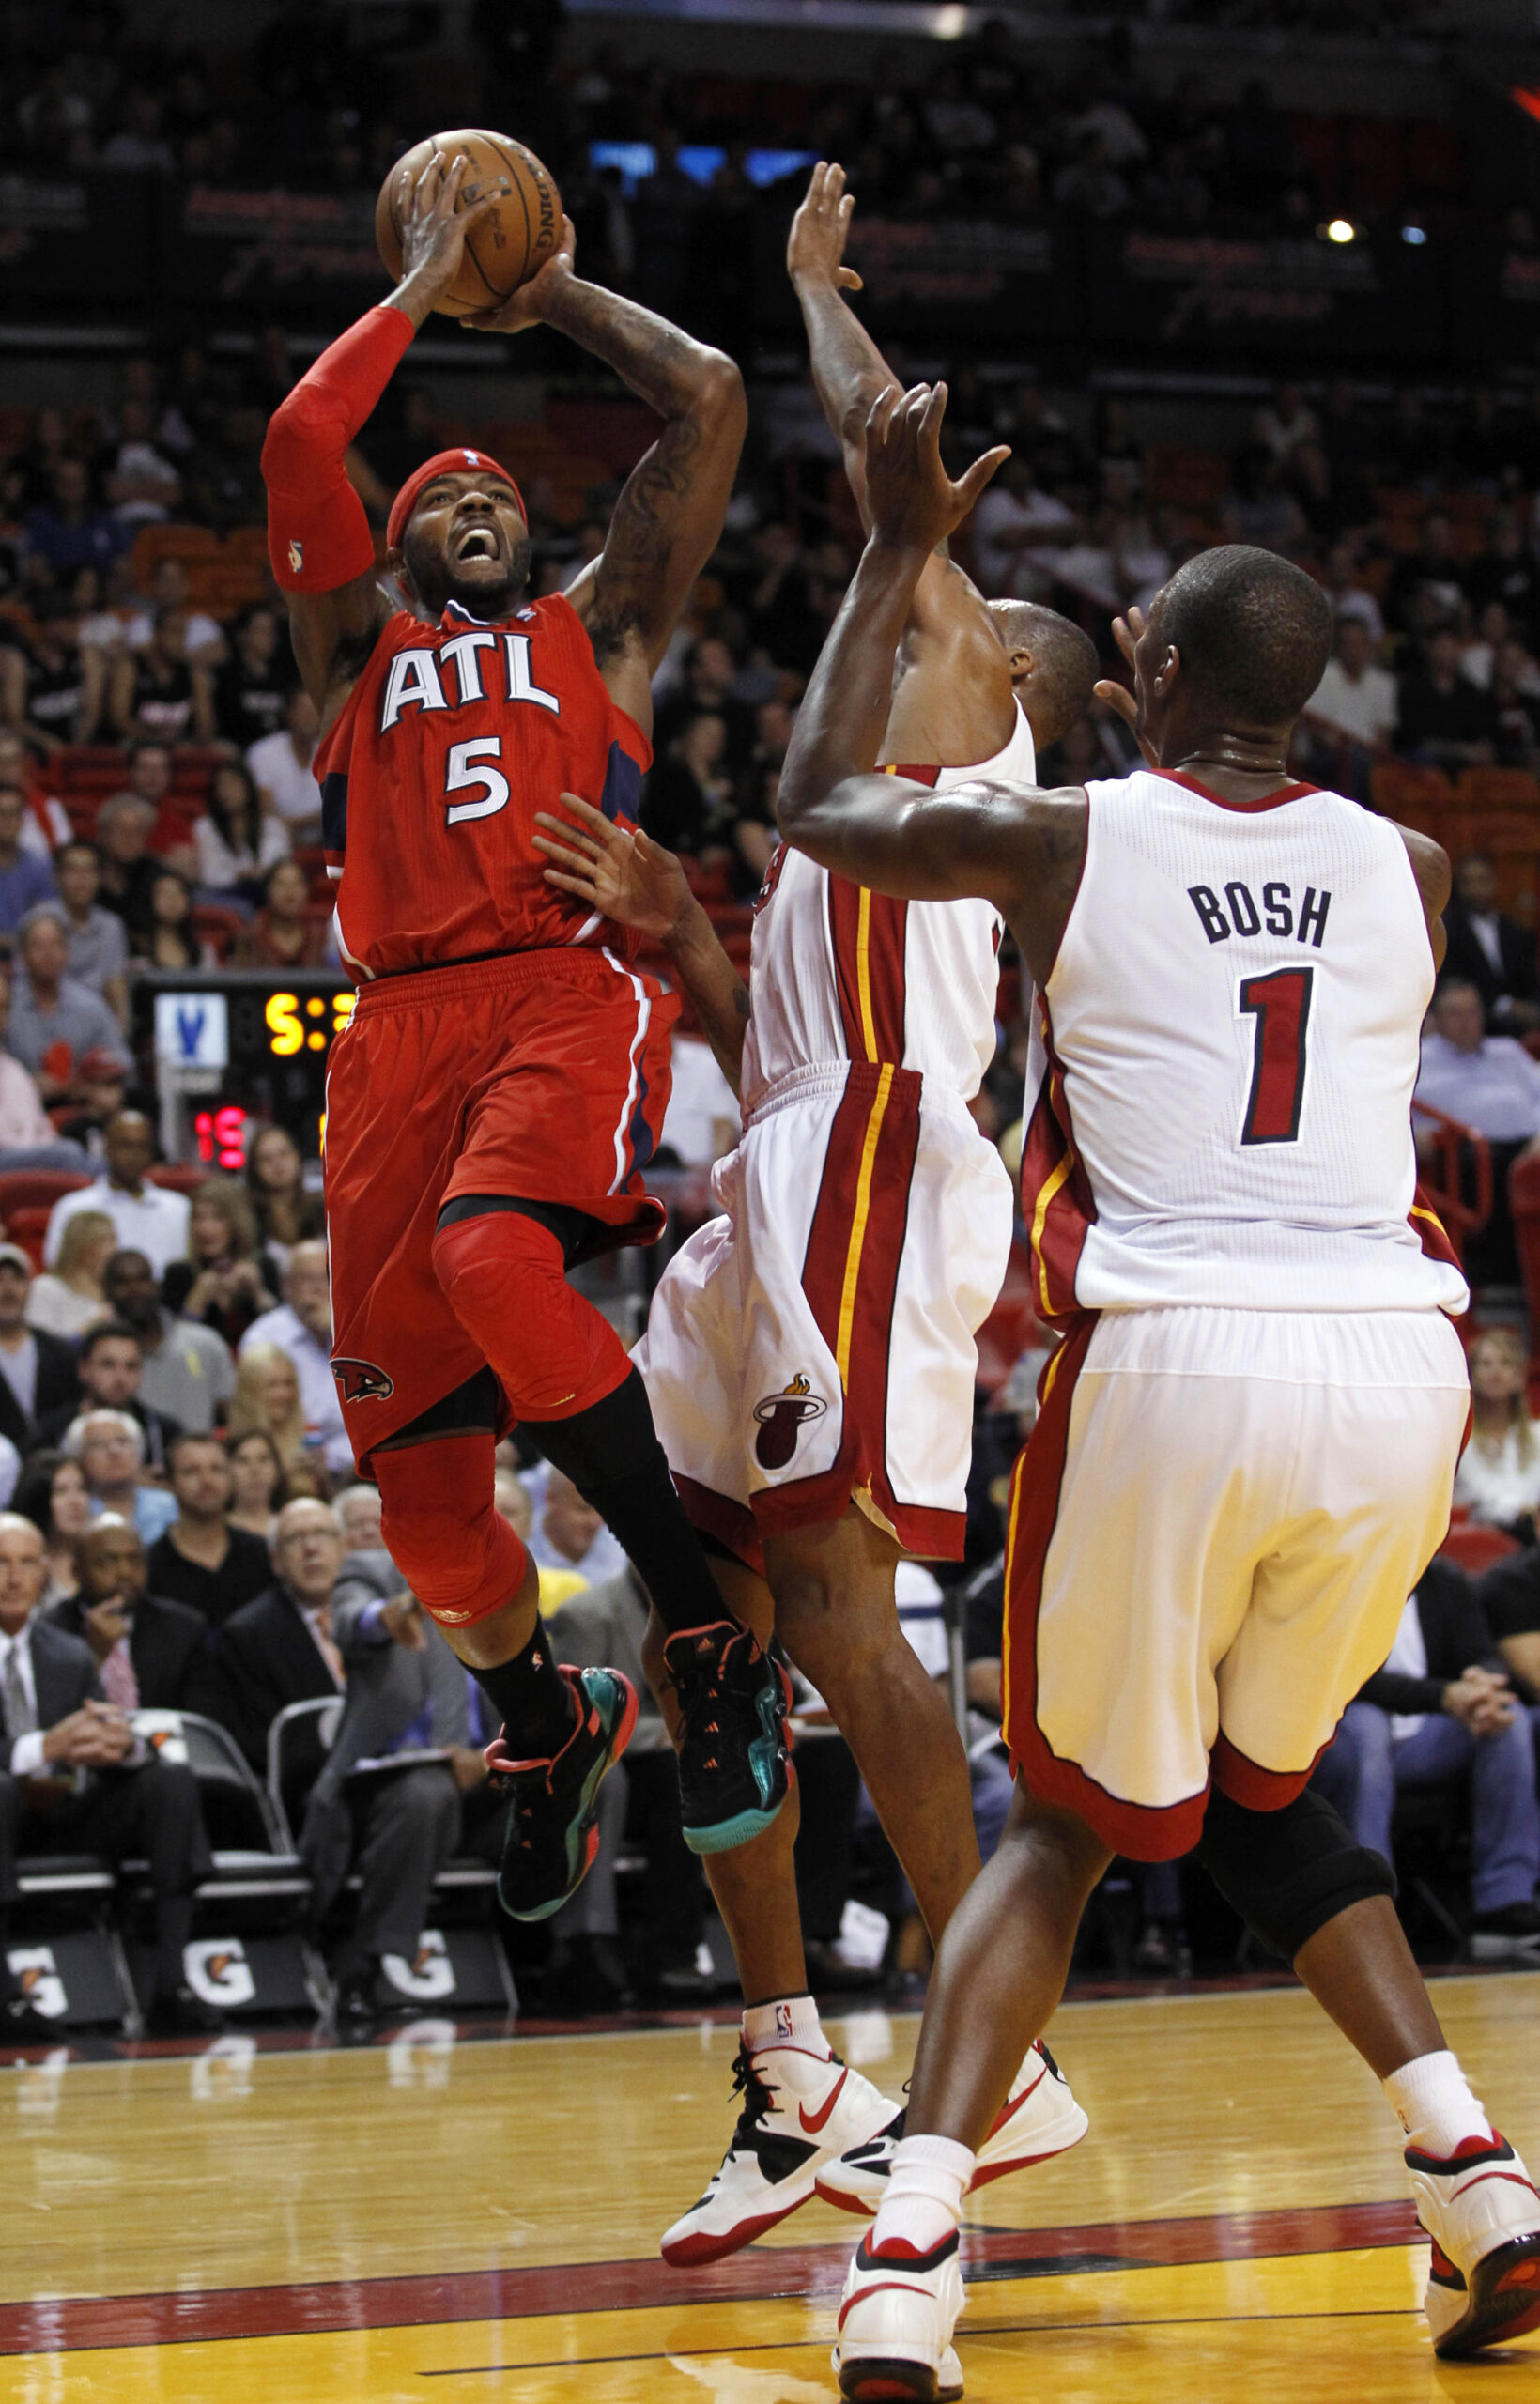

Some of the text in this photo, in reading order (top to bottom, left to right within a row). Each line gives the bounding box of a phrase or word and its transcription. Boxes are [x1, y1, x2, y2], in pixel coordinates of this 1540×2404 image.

[379, 630, 561, 736] ATL
[443, 735, 511, 827] 5
[1187, 881, 1332, 948] BOSH
[1233, 963, 1317, 1151] 1
[183, 1938, 257, 2008] G
